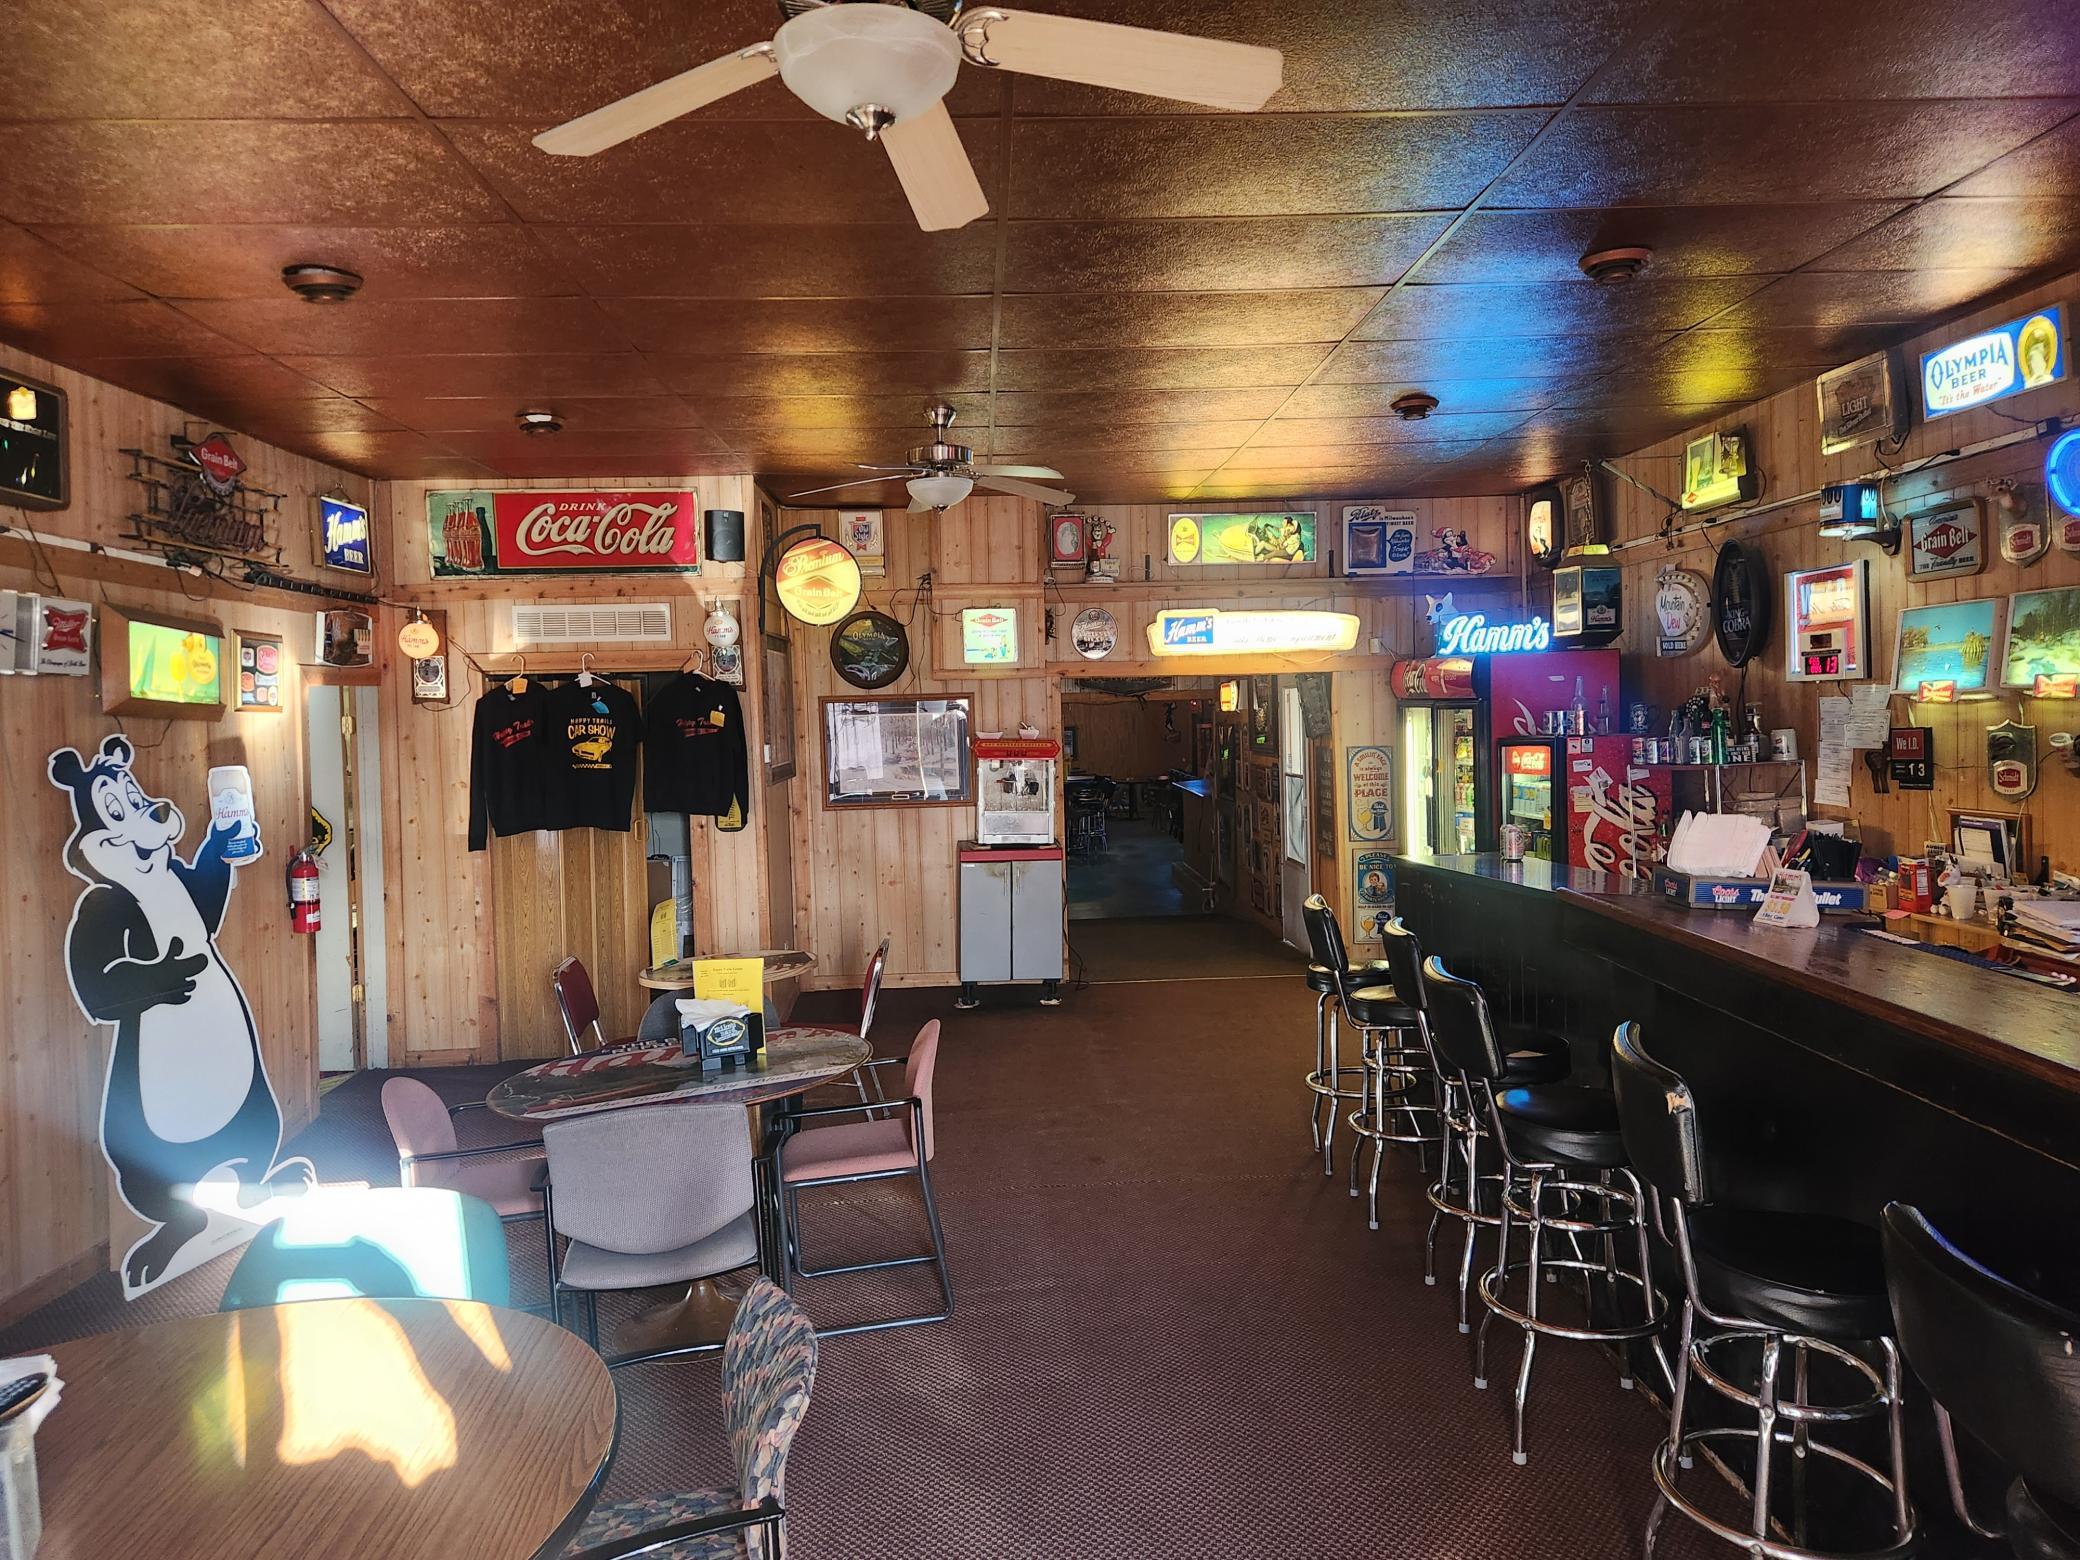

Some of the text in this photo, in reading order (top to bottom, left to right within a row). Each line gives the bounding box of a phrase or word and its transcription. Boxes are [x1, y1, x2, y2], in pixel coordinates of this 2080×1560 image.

[1931, 338, 2008, 390] OLYMPIA
[1951, 368, 1986, 389] BEER
[1841, 395, 1868, 417] LIGHT
[201, 447, 238, 470] Grain Belt
[559, 502, 606, 511] DRINK
[324, 511, 366, 553] Hamm's
[515, 502, 677, 555] Coca-Cola
[854, 531, 869, 541] Style
[858, 524, 869, 532] Old
[1920, 525, 1969, 553] Grain Belt
[344, 548, 364, 564] BEER
[783, 551, 844, 577] Premium
[1660, 594, 1685, 611] Mountain
[1665, 611, 1681, 630] Dew
[1722, 616, 1751, 633] COBRA
[852, 631, 886, 640] OLYMPIA
[1165, 616, 1213, 643] Hamm's
[1439, 614, 1550, 655] Hamm's
[567, 724, 616, 740] CAR SHOW
[1895, 736, 1919, 750] We I.D.
[1353, 772, 1389, 782] WELCOME
[1354, 788, 1388, 798] PLACE
[1712, 885, 1740, 896] Coors
[1714, 894, 1737, 904] LIGHT
